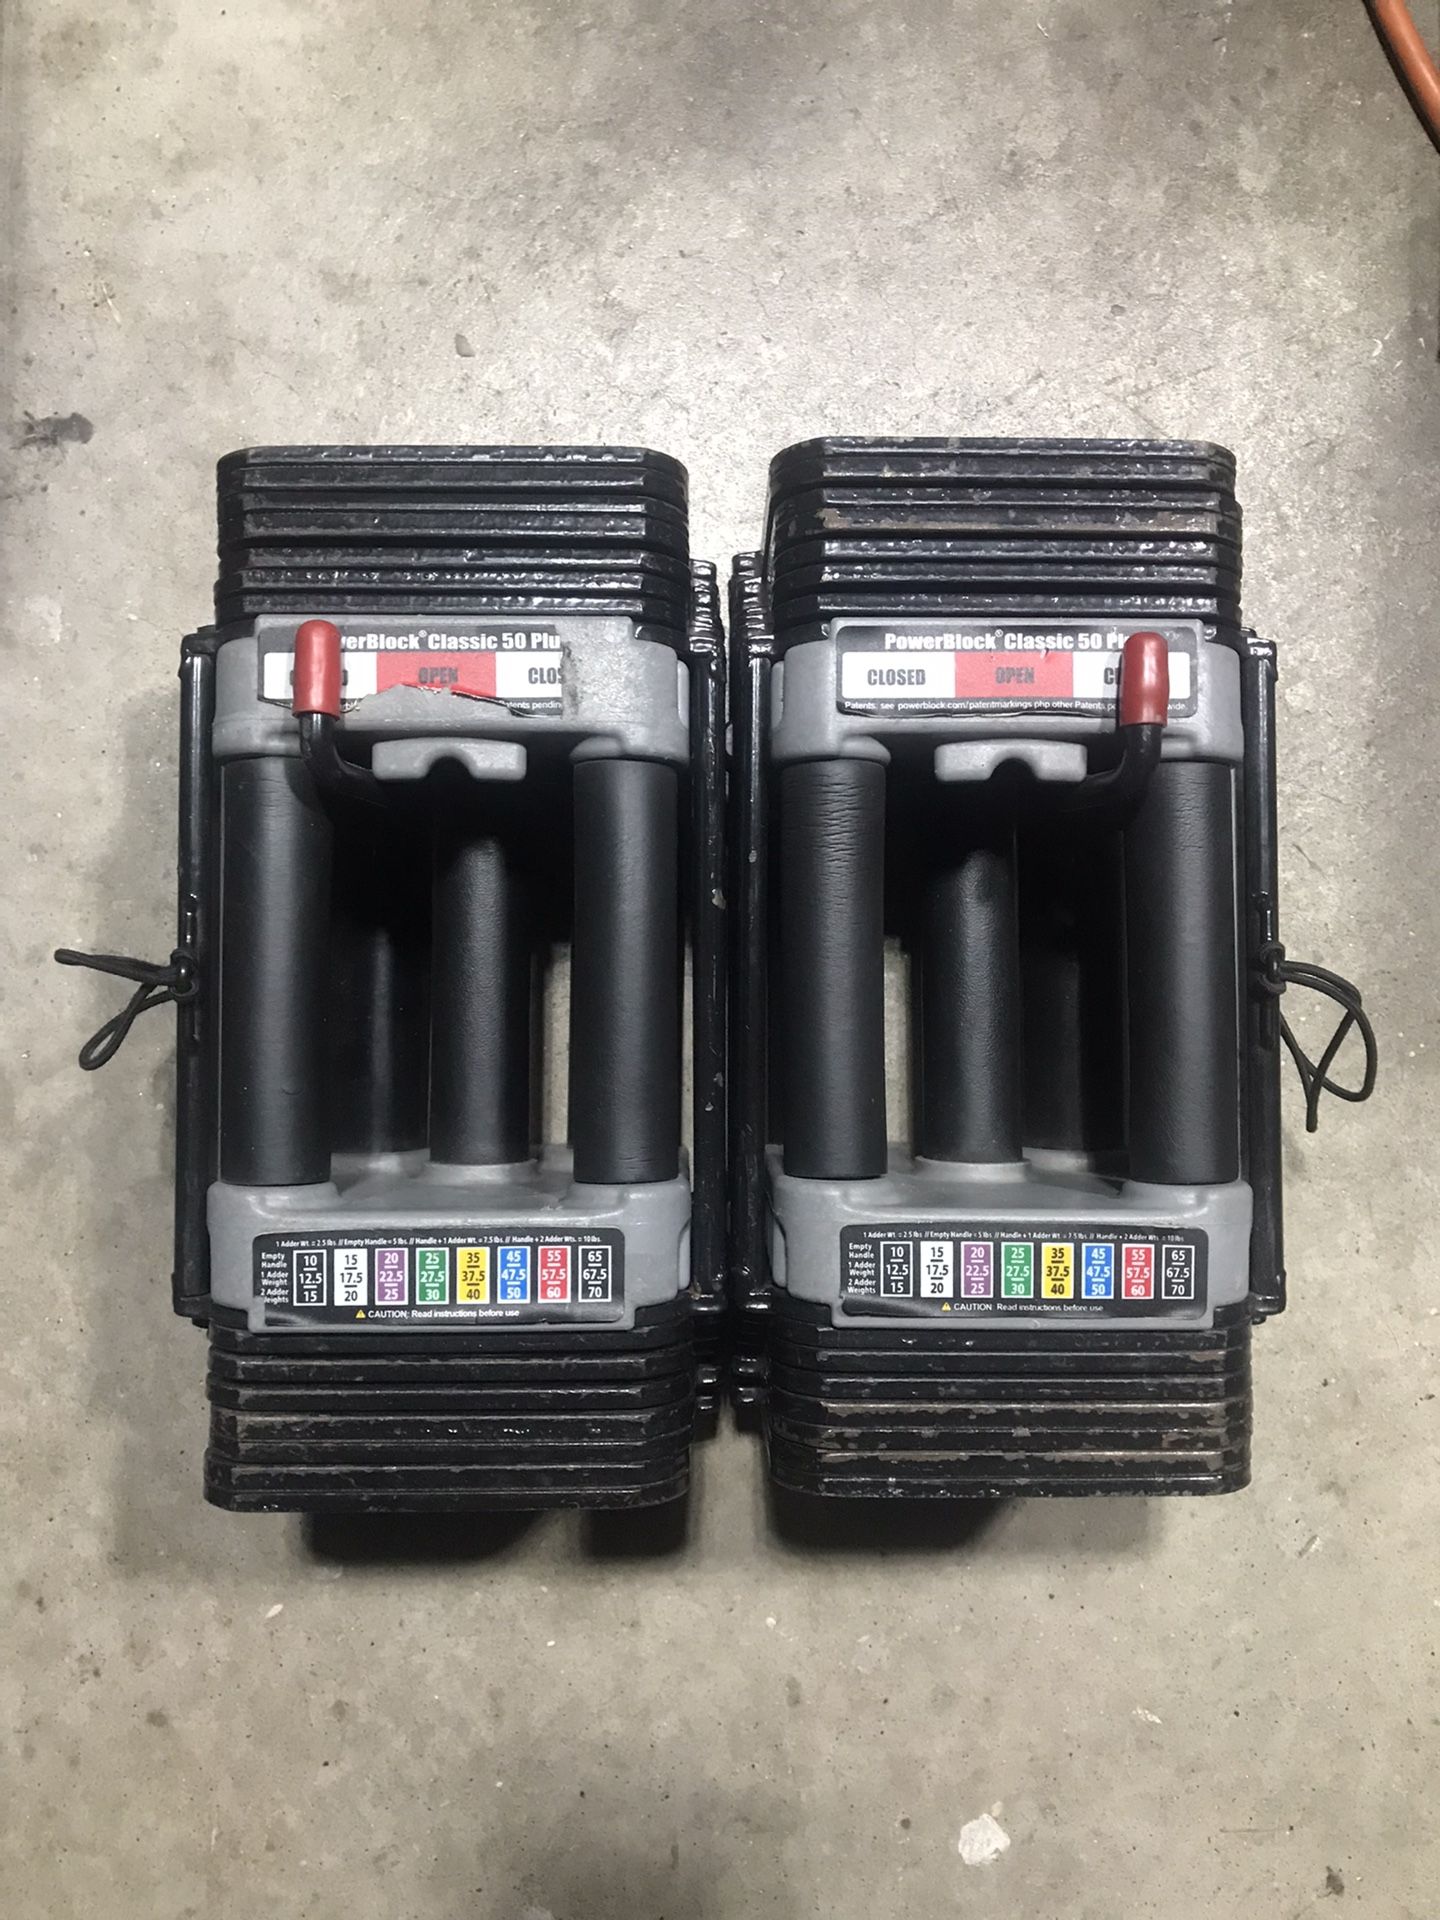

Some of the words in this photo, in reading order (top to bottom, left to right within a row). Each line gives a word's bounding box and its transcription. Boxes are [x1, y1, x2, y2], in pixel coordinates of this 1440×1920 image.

[428, 633, 498, 649] Classic
[502, 633, 526, 649] 50
[531, 633, 561, 649] Plu
[1004, 632, 1074, 649] Classic
[1078, 632, 1102, 649] 50
[418, 667, 458, 684] OPEN
[867, 669, 926, 685] CLOSED
[995, 667, 1034, 684] OPEN
[532, 700, 561, 710] pendin
[1052, 701, 1073, 709] other
[344, 1239, 364, 1247] Empty
[415, 1237, 437, 1245] Handle
[448, 1236, 466, 1244] Adder
[512, 1235, 533, 1243] Handle
[849, 1242, 872, 1251] Empty
[262, 1252, 285, 1261] Empty
[303, 1255, 317, 1266] 10
[345, 1254, 358, 1265] 15
[384, 1253, 399, 1264] 20
[425, 1253, 440, 1264] 25
[467, 1252, 480, 1264] 35
[506, 1251, 521, 1262] 45
[547, 1250, 561, 1262] 55
[588, 1250, 602, 1262] 65
[849, 1251, 874, 1259] Handle
[891, 1246, 904, 1257] 10
[930, 1247, 944, 1258] 15
[970, 1247, 985, 1258] 20
[1011, 1247, 1025, 1259] 25
[1051, 1248, 1065, 1259] 35
[1091, 1248, 1106, 1259] 45
[1131, 1249, 1145, 1260] 55
[1171, 1250, 1185, 1261] 65
[299, 1273, 322, 1284] 12.5
[340, 1272, 363, 1283] 17.5
[379, 1271, 403, 1282] 22.5
[420, 1271, 445, 1282] 27.5
[462, 1271, 485, 1282] 37.5
[501, 1269, 526, 1280] 47.5
[542, 1269, 566, 1280] 57.5
[583, 1269, 607, 1280] 67.5
[849, 1269, 874, 1278] Weight
[886, 1264, 909, 1275] 12.5
[926, 1265, 949, 1276] 17.5
[966, 1265, 989, 1276] 22.5
[1006, 1266, 1030, 1277] 27.5
[1046, 1266, 1070, 1277] 37.5
[1086, 1266, 1111, 1277] 47.5
[1126, 1267, 1150, 1278] 57.5
[1166, 1268, 1190, 1279] 67.5
[262, 1278, 287, 1287] Weight
[854, 1278, 876, 1286] Adder
[267, 1288, 289, 1296] Adder
[304, 1291, 317, 1302] 15
[345, 1290, 358, 1302] 20
[384, 1289, 399, 1300] 25
[425, 1289, 440, 1300] 30
[466, 1289, 480, 1300] 40
[507, 1287, 521, 1298] 50
[547, 1287, 560, 1298] 60
[588, 1287, 602, 1298] 70
[847, 1286, 876, 1295] Weights
[891, 1282, 903, 1293] 15
[930, 1283, 944, 1294] 20
[970, 1283, 985, 1294] 25
[1011, 1283, 1025, 1295] 30
[1051, 1284, 1065, 1295] 40
[1091, 1284, 1106, 1295] 50
[1131, 1285, 1145, 1296] 60
[1171, 1285, 1185, 1296] 70
[997, 1303, 1017, 1311] Read
[1019, 1303, 1061, 1311] instructions
[412, 1310, 433, 1318] Read
[434, 1310, 476, 1318] instructions
[478, 1309, 503, 1317] before
